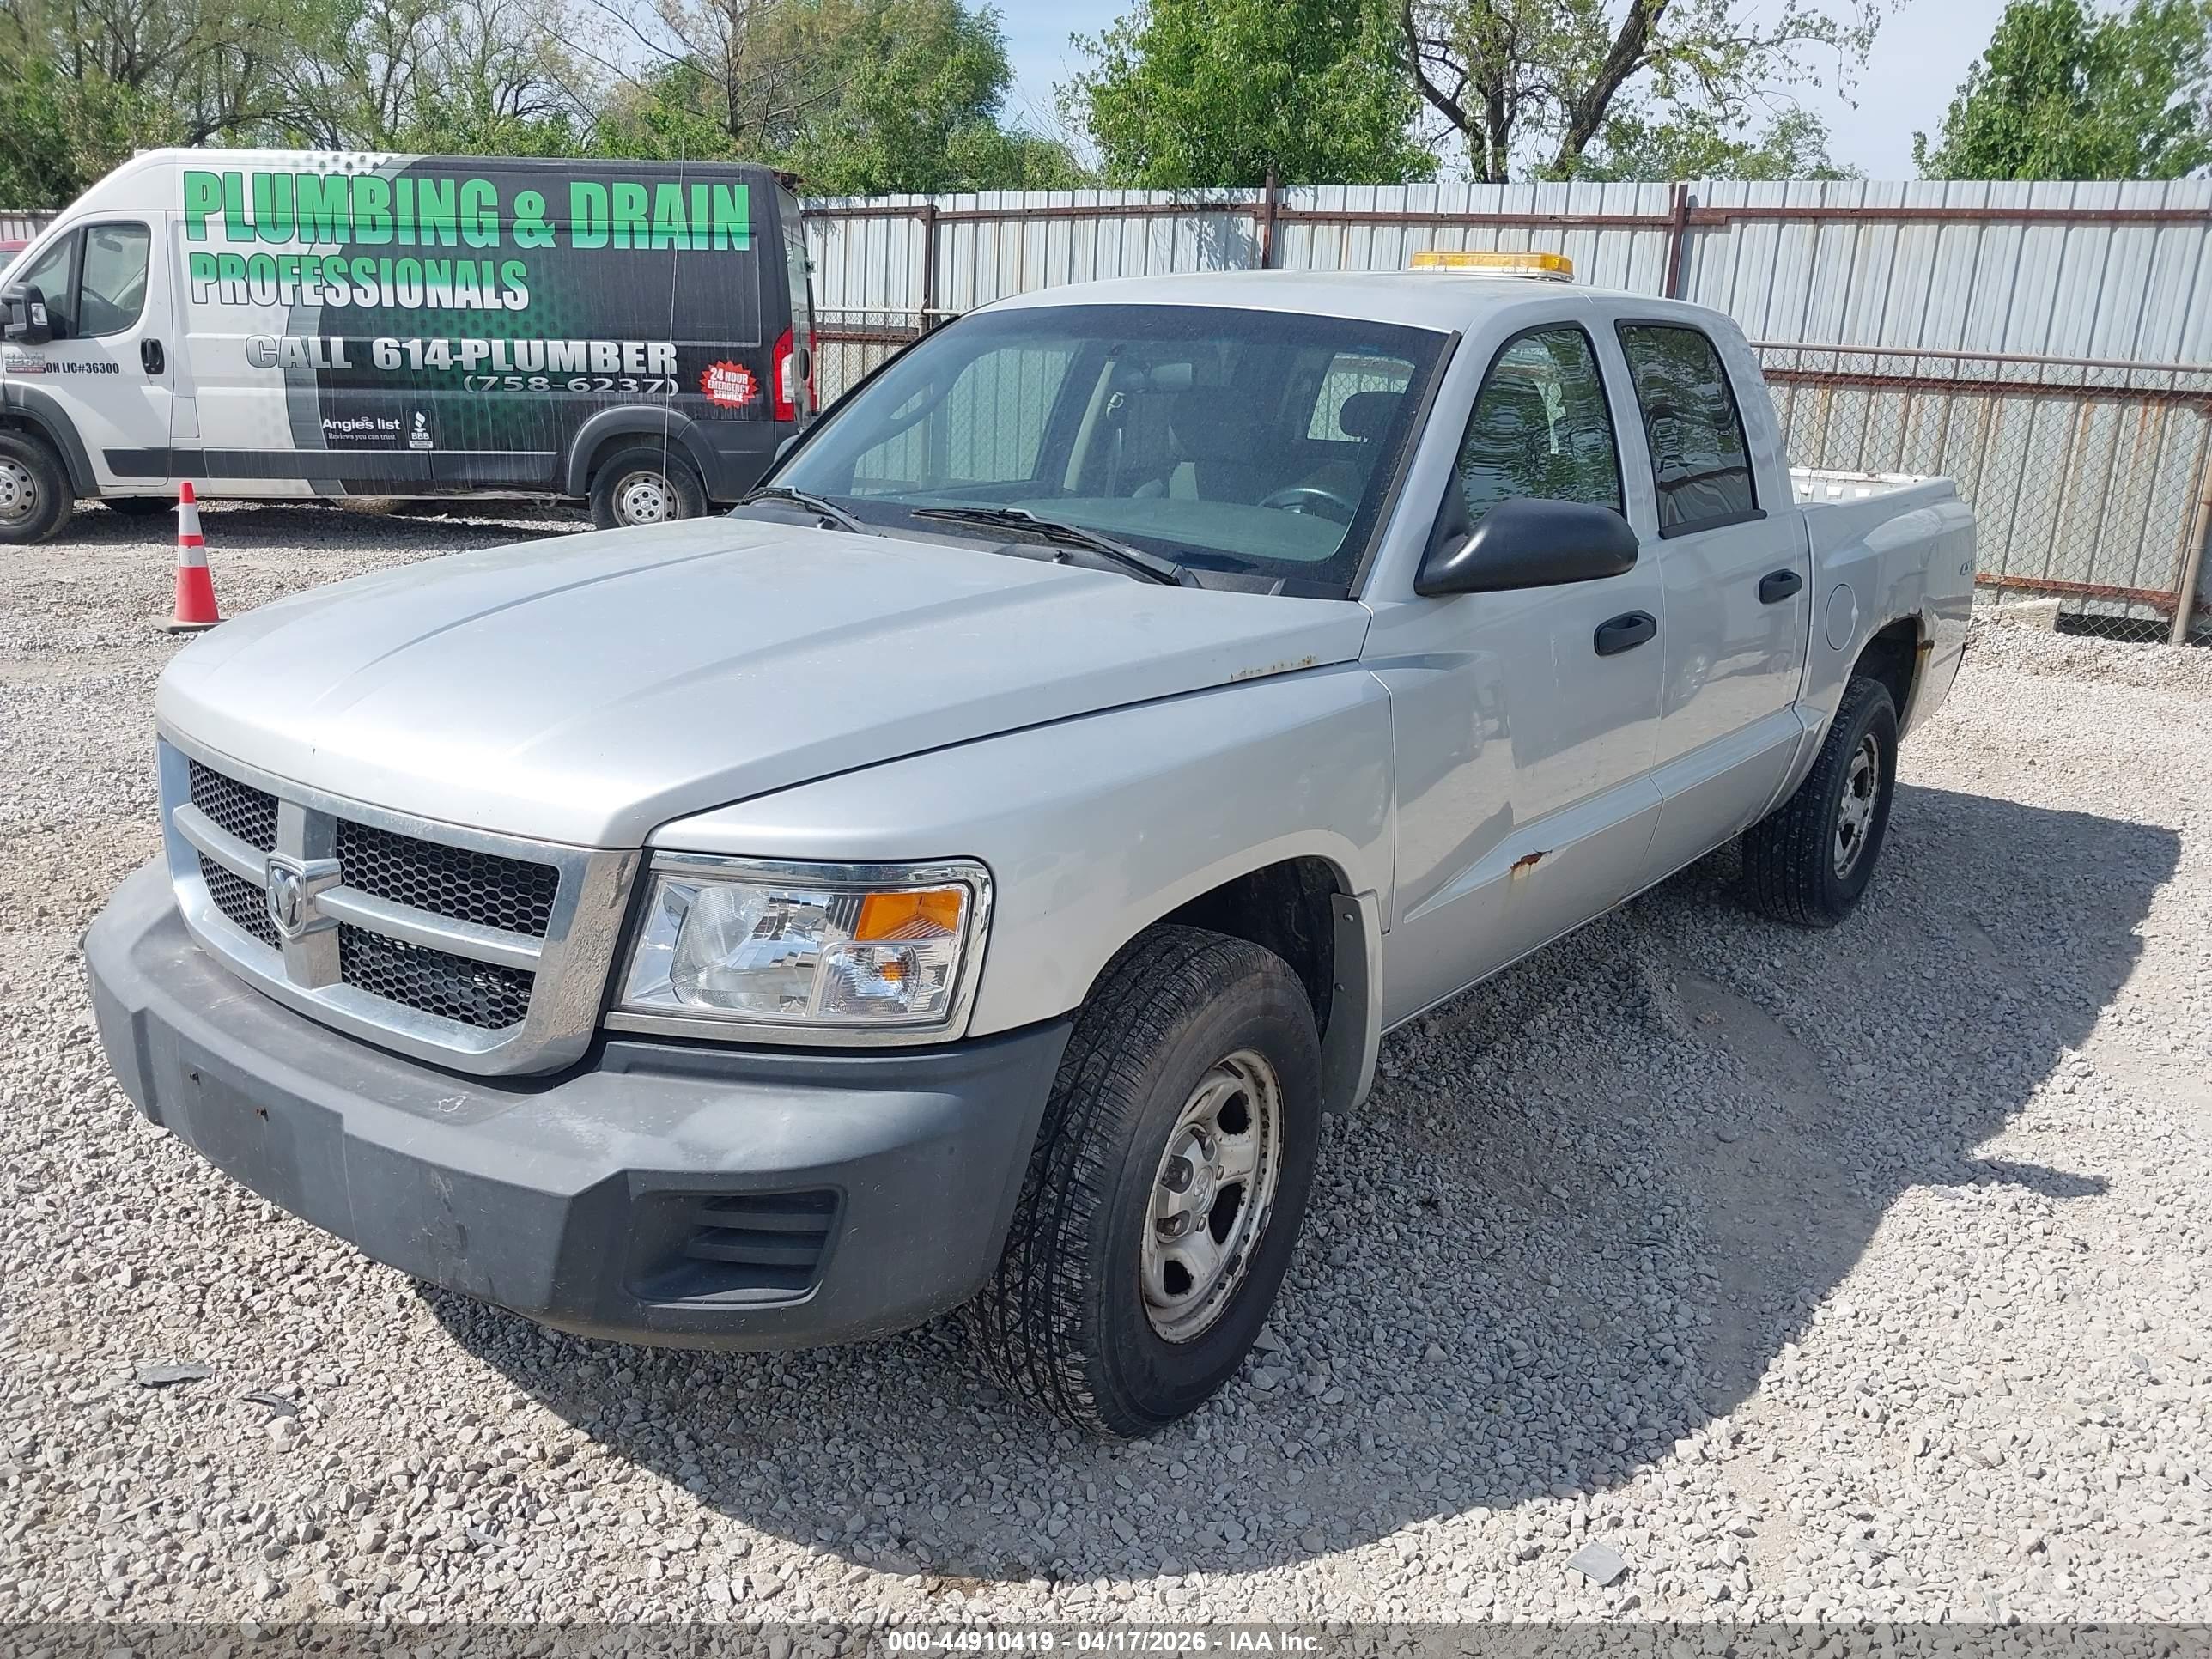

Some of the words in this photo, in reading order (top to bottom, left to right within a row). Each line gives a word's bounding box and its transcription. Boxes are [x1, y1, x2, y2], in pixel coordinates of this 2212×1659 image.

[183, 171, 501, 249] PLUMBING
[514, 191, 556, 249] &
[570, 181, 750, 251] DRAIN
[189, 252, 529, 311] PROFESSIONALS
[246, 335, 353, 369] CALL
[372, 337, 678, 374] 614-PLUMBER
[62, 362, 119, 374] LIC#36300
[710, 368, 725, 380] 24
[725, 371, 749, 385] HOUR
[464, 375, 679, 397] (758-6237)
[708, 380, 750, 394] EMERGENCY
[714, 389, 744, 402] SERVICE
[378, 418, 401, 430] list
[328, 432, 355, 441] Reviews
